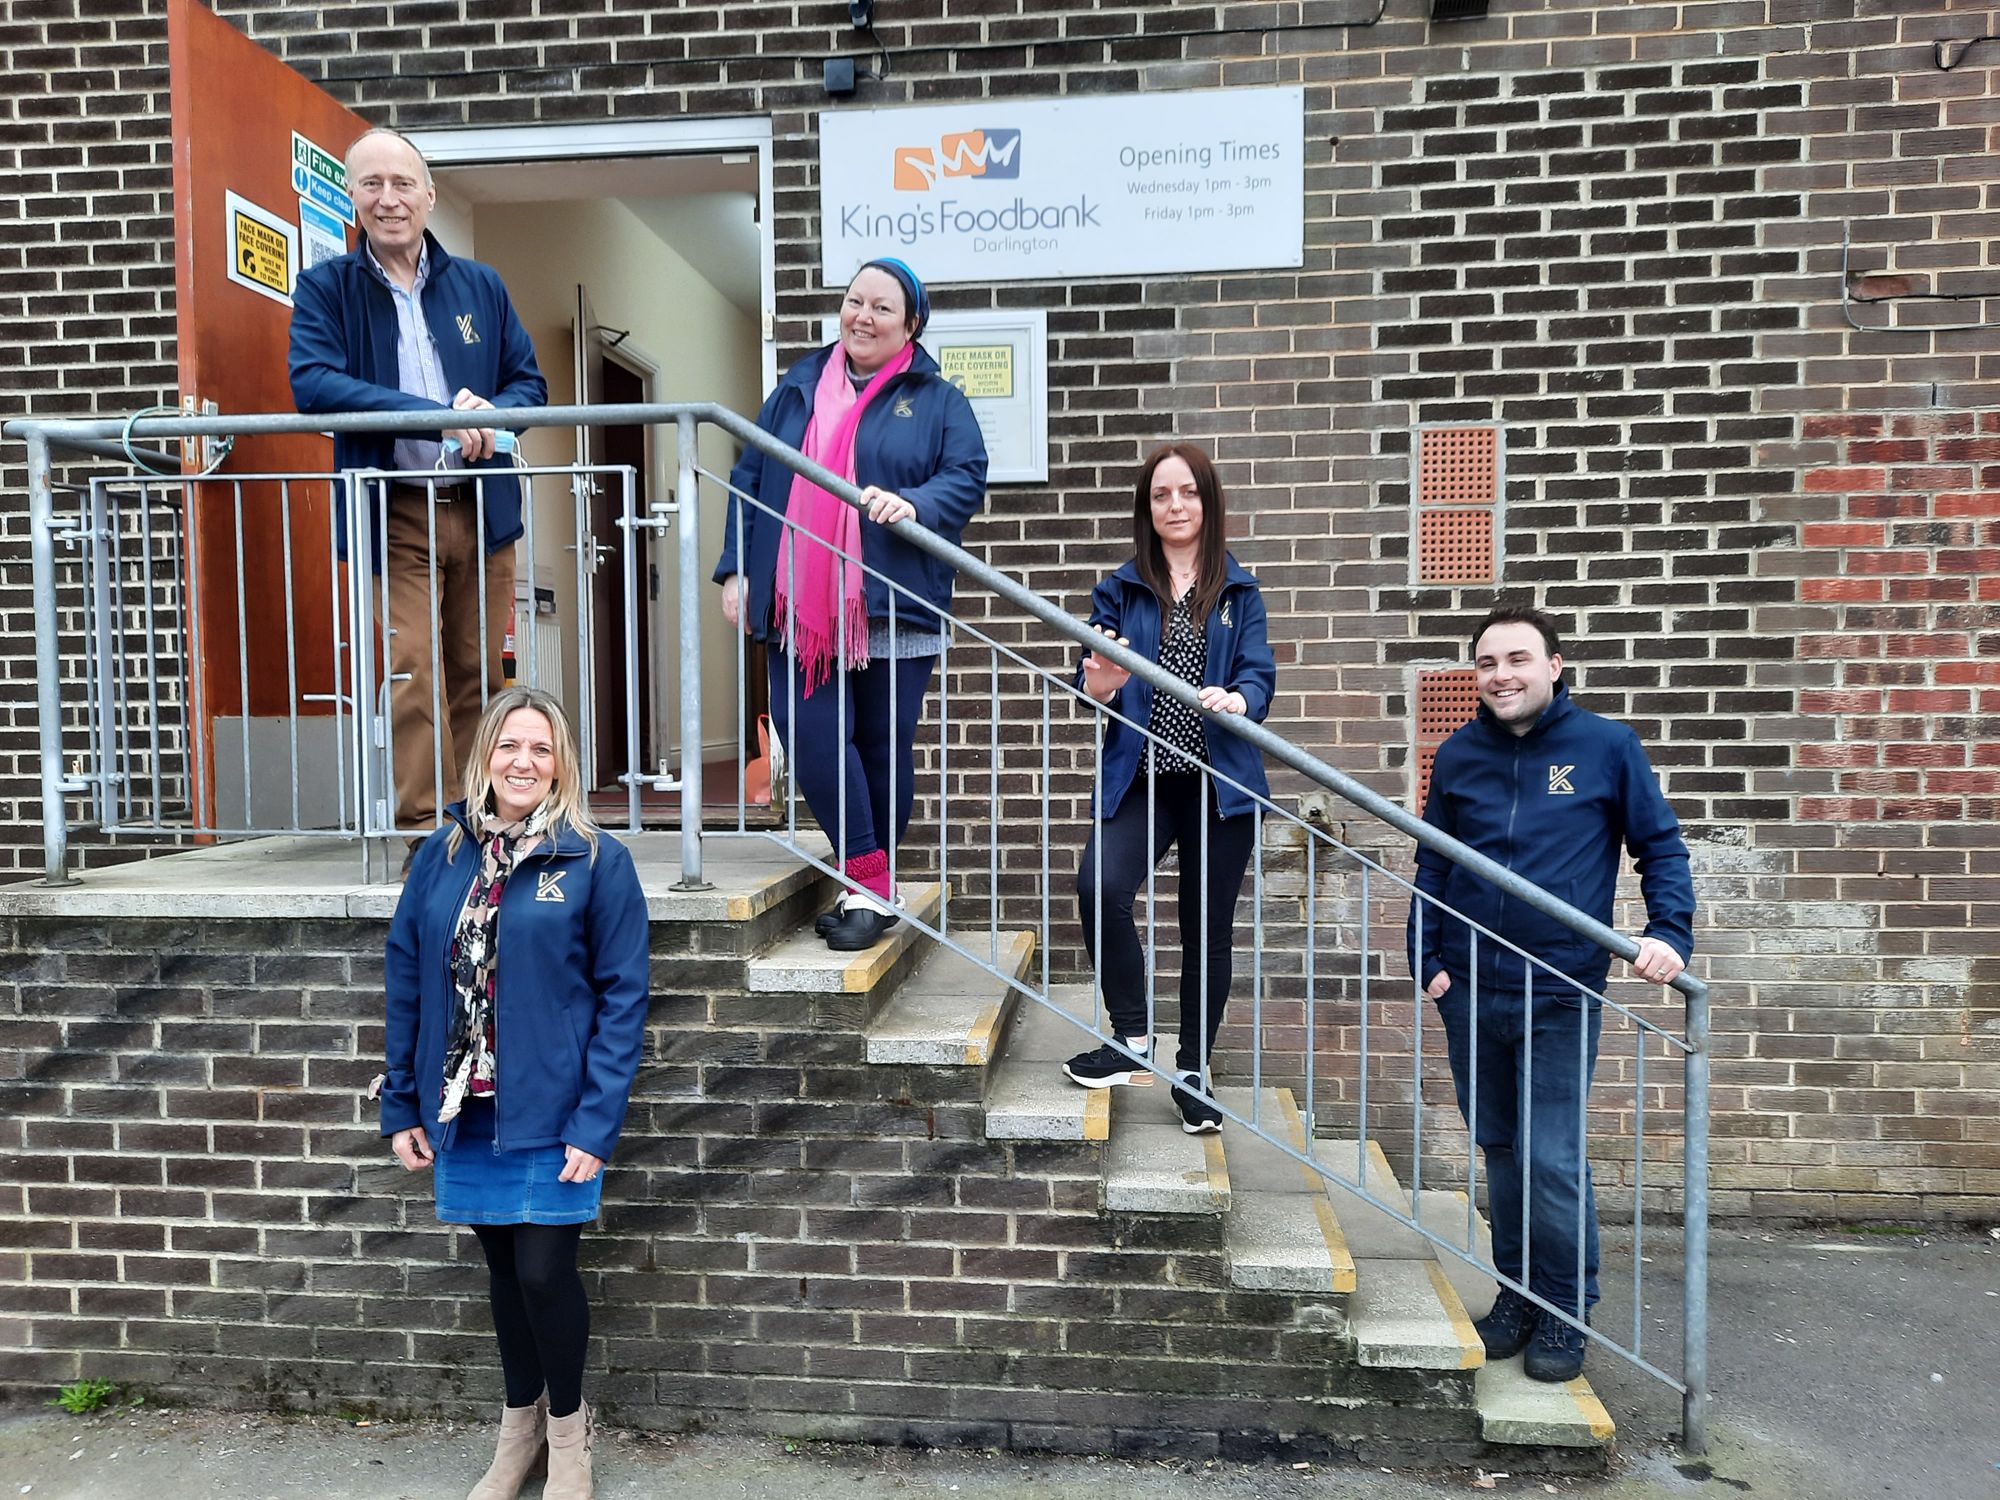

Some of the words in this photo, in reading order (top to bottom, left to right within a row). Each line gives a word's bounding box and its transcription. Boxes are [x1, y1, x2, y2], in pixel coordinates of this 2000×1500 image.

[312, 151, 333, 178] Fire
[1119, 142, 1212, 172] Opening
[1219, 139, 1280, 162] Times
[1127, 178, 1200, 195] Wednesday
[1205, 178, 1231, 193] 1pm
[1244, 176, 1271, 191] 3pm
[311, 178, 333, 202] Keep
[333, 192, 352, 214] clear
[940, 193, 1102, 234] Foodbank
[1144, 206, 1183, 222] Friday
[1188, 205, 1214, 220] 1pm
[1227, 203, 1254, 218] 3pm
[240, 220, 256, 236] FACE
[257, 228, 275, 245] MASK
[275, 238, 284, 250] OR
[239, 231, 255, 247] FACE
[255, 239, 285, 262] COVERING
[973, 236, 1059, 255] Darlington
[260, 255, 275, 268] MUST
[264, 264, 279, 278] WORN
[260, 271, 267, 280] TO
[267, 273, 283, 288] ENTER
[946, 352, 967, 361] FACE
[969, 351, 993, 361] MASK
[995, 351, 1007, 360] OR
[944, 362, 965, 371] FACE
[967, 361, 1009, 371] COVERING
